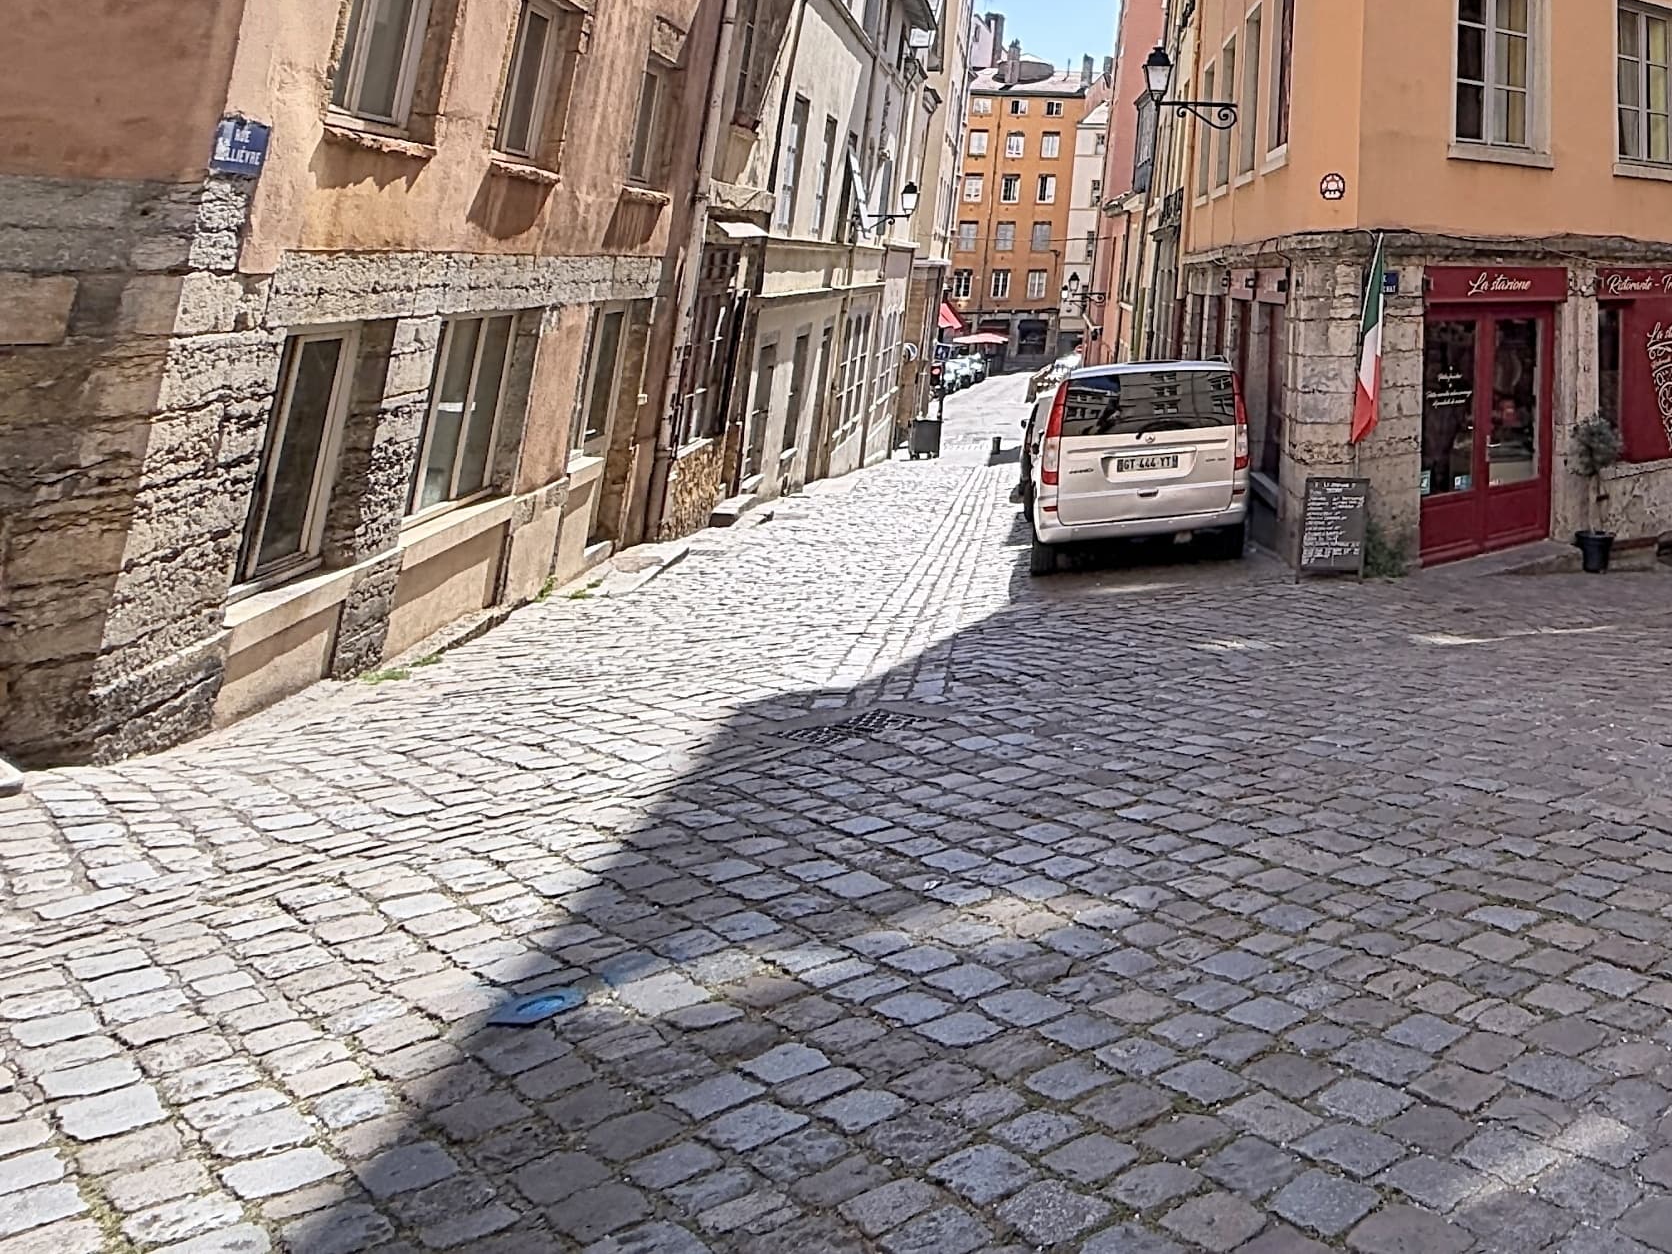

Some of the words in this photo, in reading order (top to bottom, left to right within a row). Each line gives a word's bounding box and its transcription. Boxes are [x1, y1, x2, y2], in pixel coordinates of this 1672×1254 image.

[234, 128, 252, 143] RUE
[1467, 271, 1489, 296] La
[1490, 273, 1532, 291] stazione
[1646, 321, 1664, 347] La
